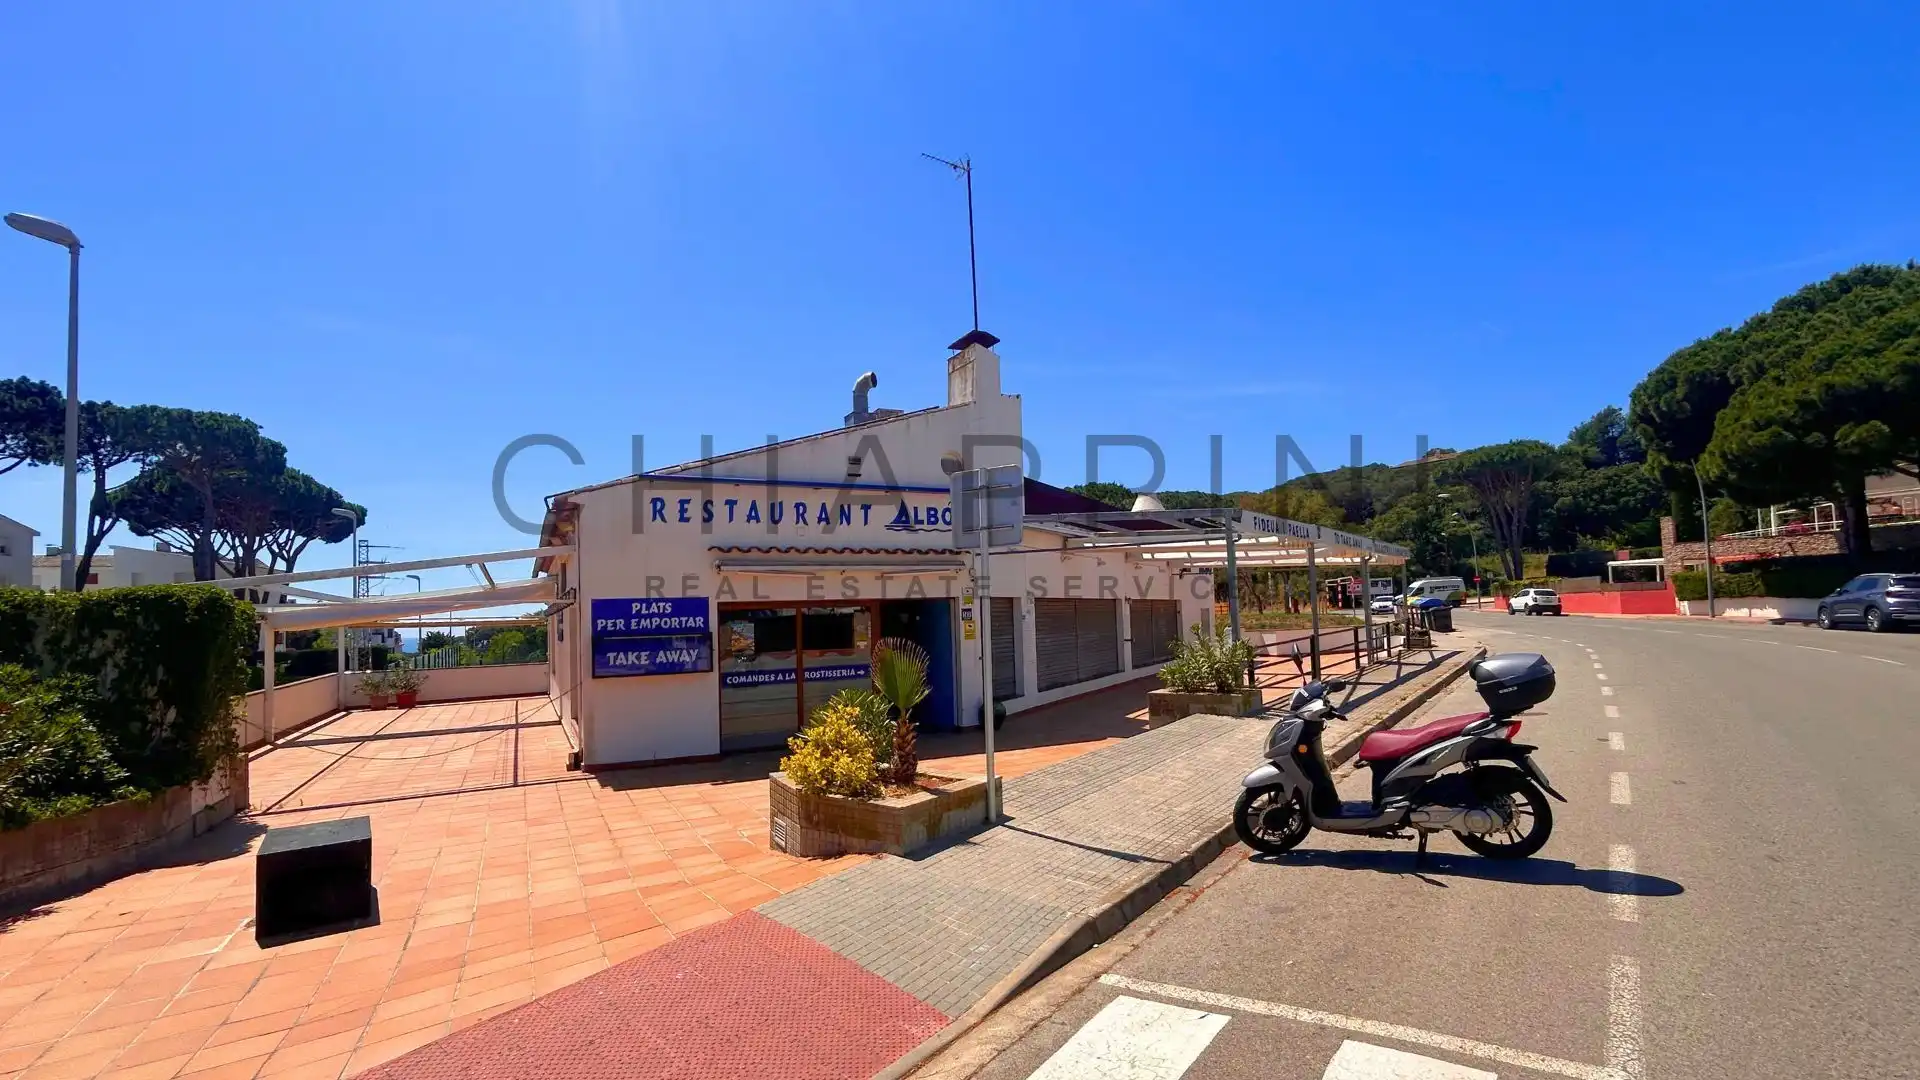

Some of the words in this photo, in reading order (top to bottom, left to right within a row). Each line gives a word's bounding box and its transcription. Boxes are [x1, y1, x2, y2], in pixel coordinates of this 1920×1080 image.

[650, 496, 872, 527] RESTAURANT
[1288, 523, 1310, 539] PAELLA
[631, 602, 672, 615] PLATS
[597, 619, 626, 631] PER
[630, 616, 704, 630] EMPORTAR
[606, 651, 650, 666] TAKE
[655, 648, 699, 664] AWAY
[726, 674, 776, 684] COMANDES
[777, 673, 784, 681] A
[785, 672, 796, 681] LA
[804, 668, 856, 679] ROSTISSERIA
